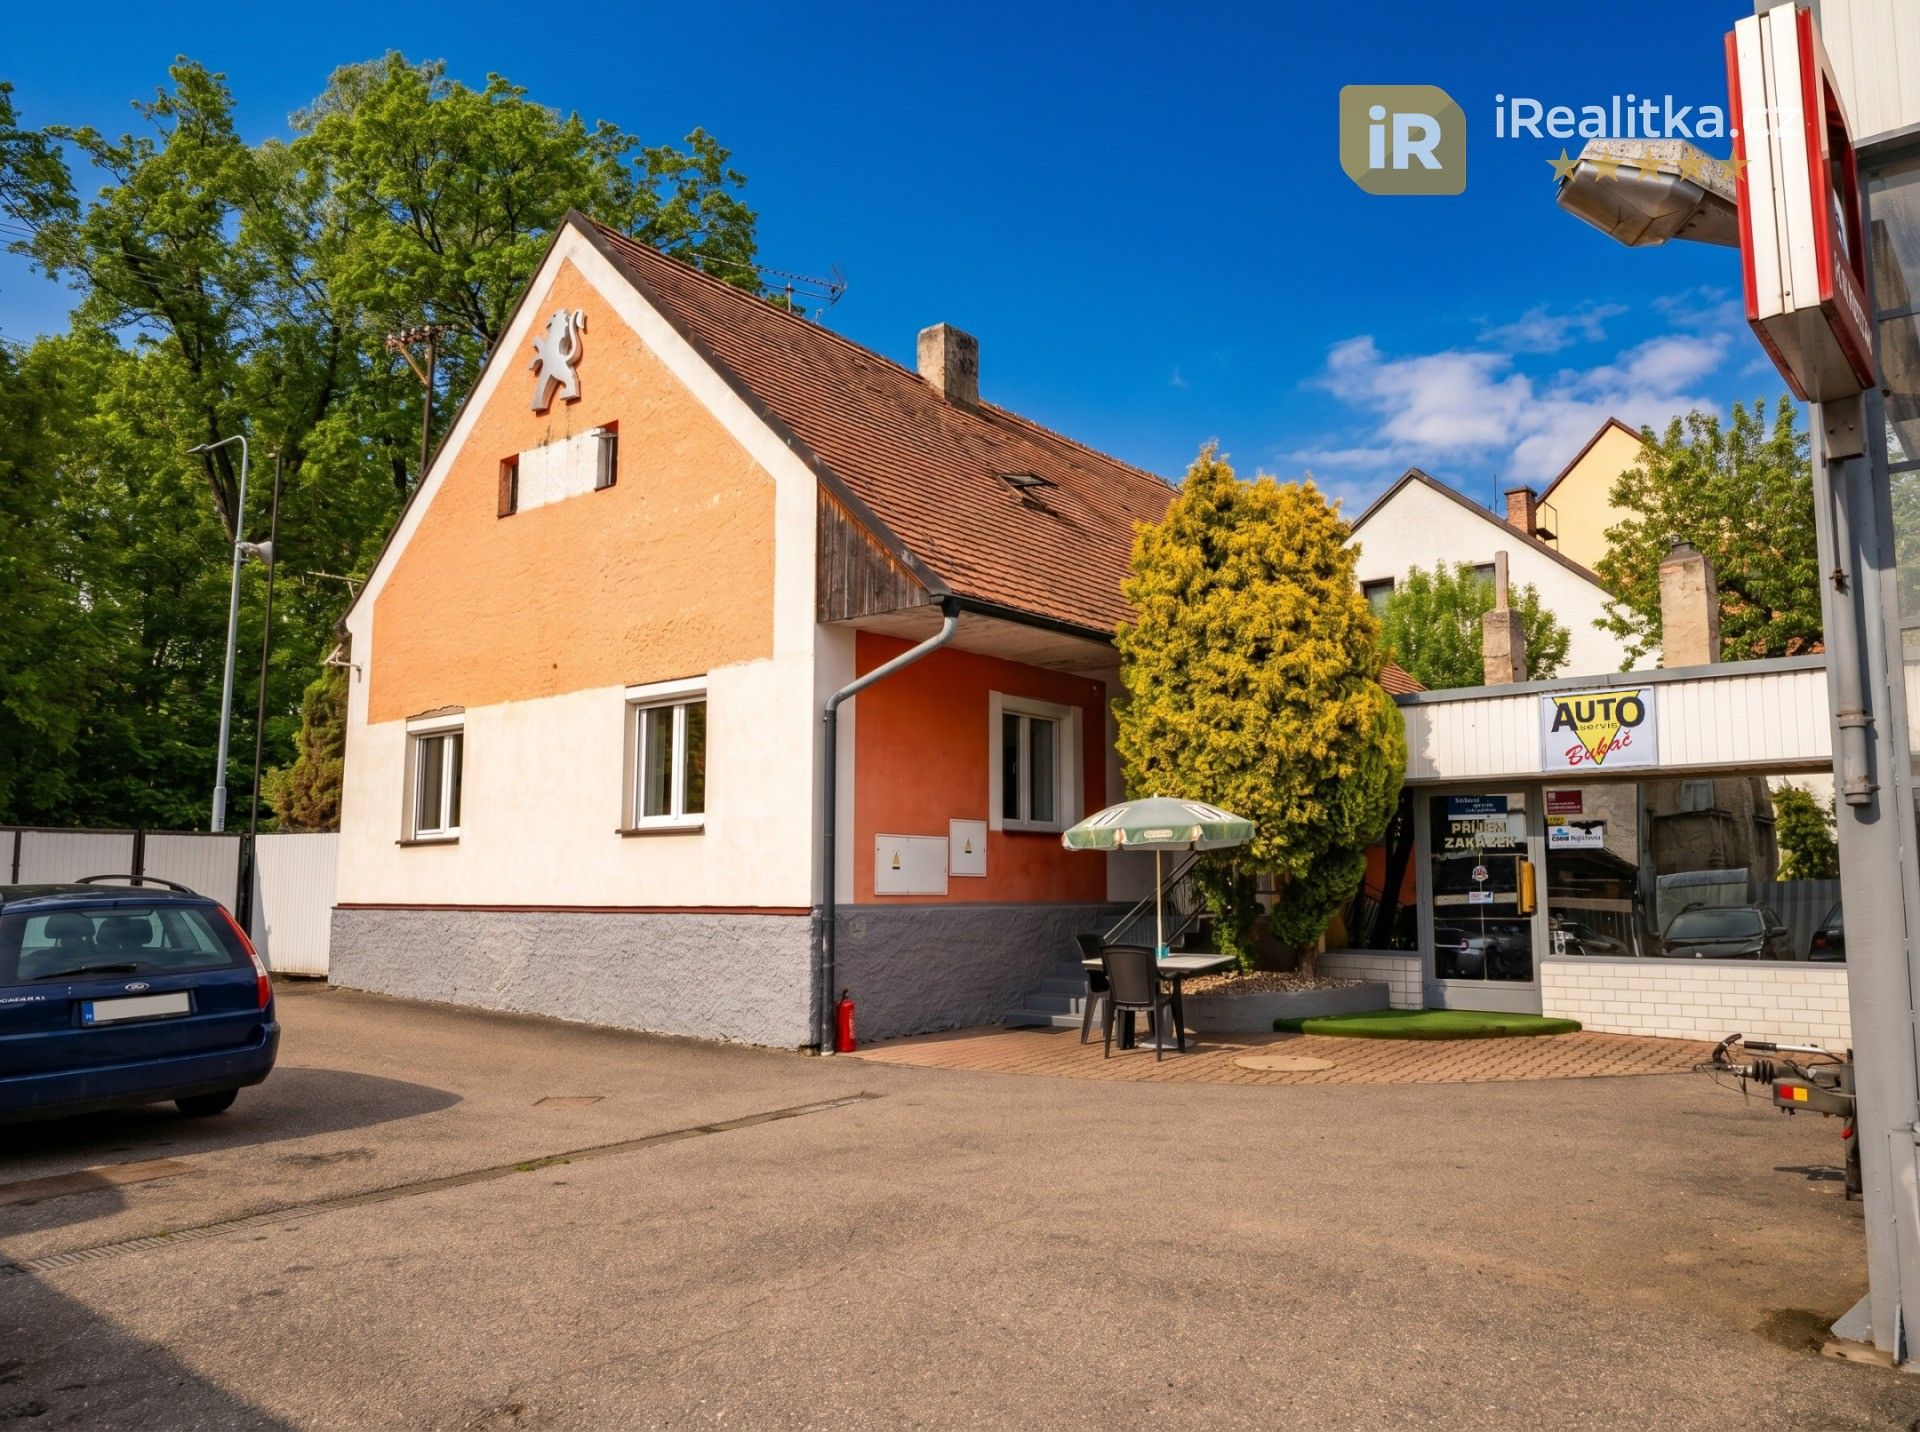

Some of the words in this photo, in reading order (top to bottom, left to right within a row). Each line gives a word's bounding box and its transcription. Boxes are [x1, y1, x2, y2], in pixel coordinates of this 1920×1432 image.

[1551, 696, 1645, 732] AUTO
[1580, 721, 1618, 731] servis
[1565, 730, 1633, 765] Bukač
[1451, 820, 1507, 834] PŘÍJEM
[1444, 834, 1516, 848] ZAKÁZEK
